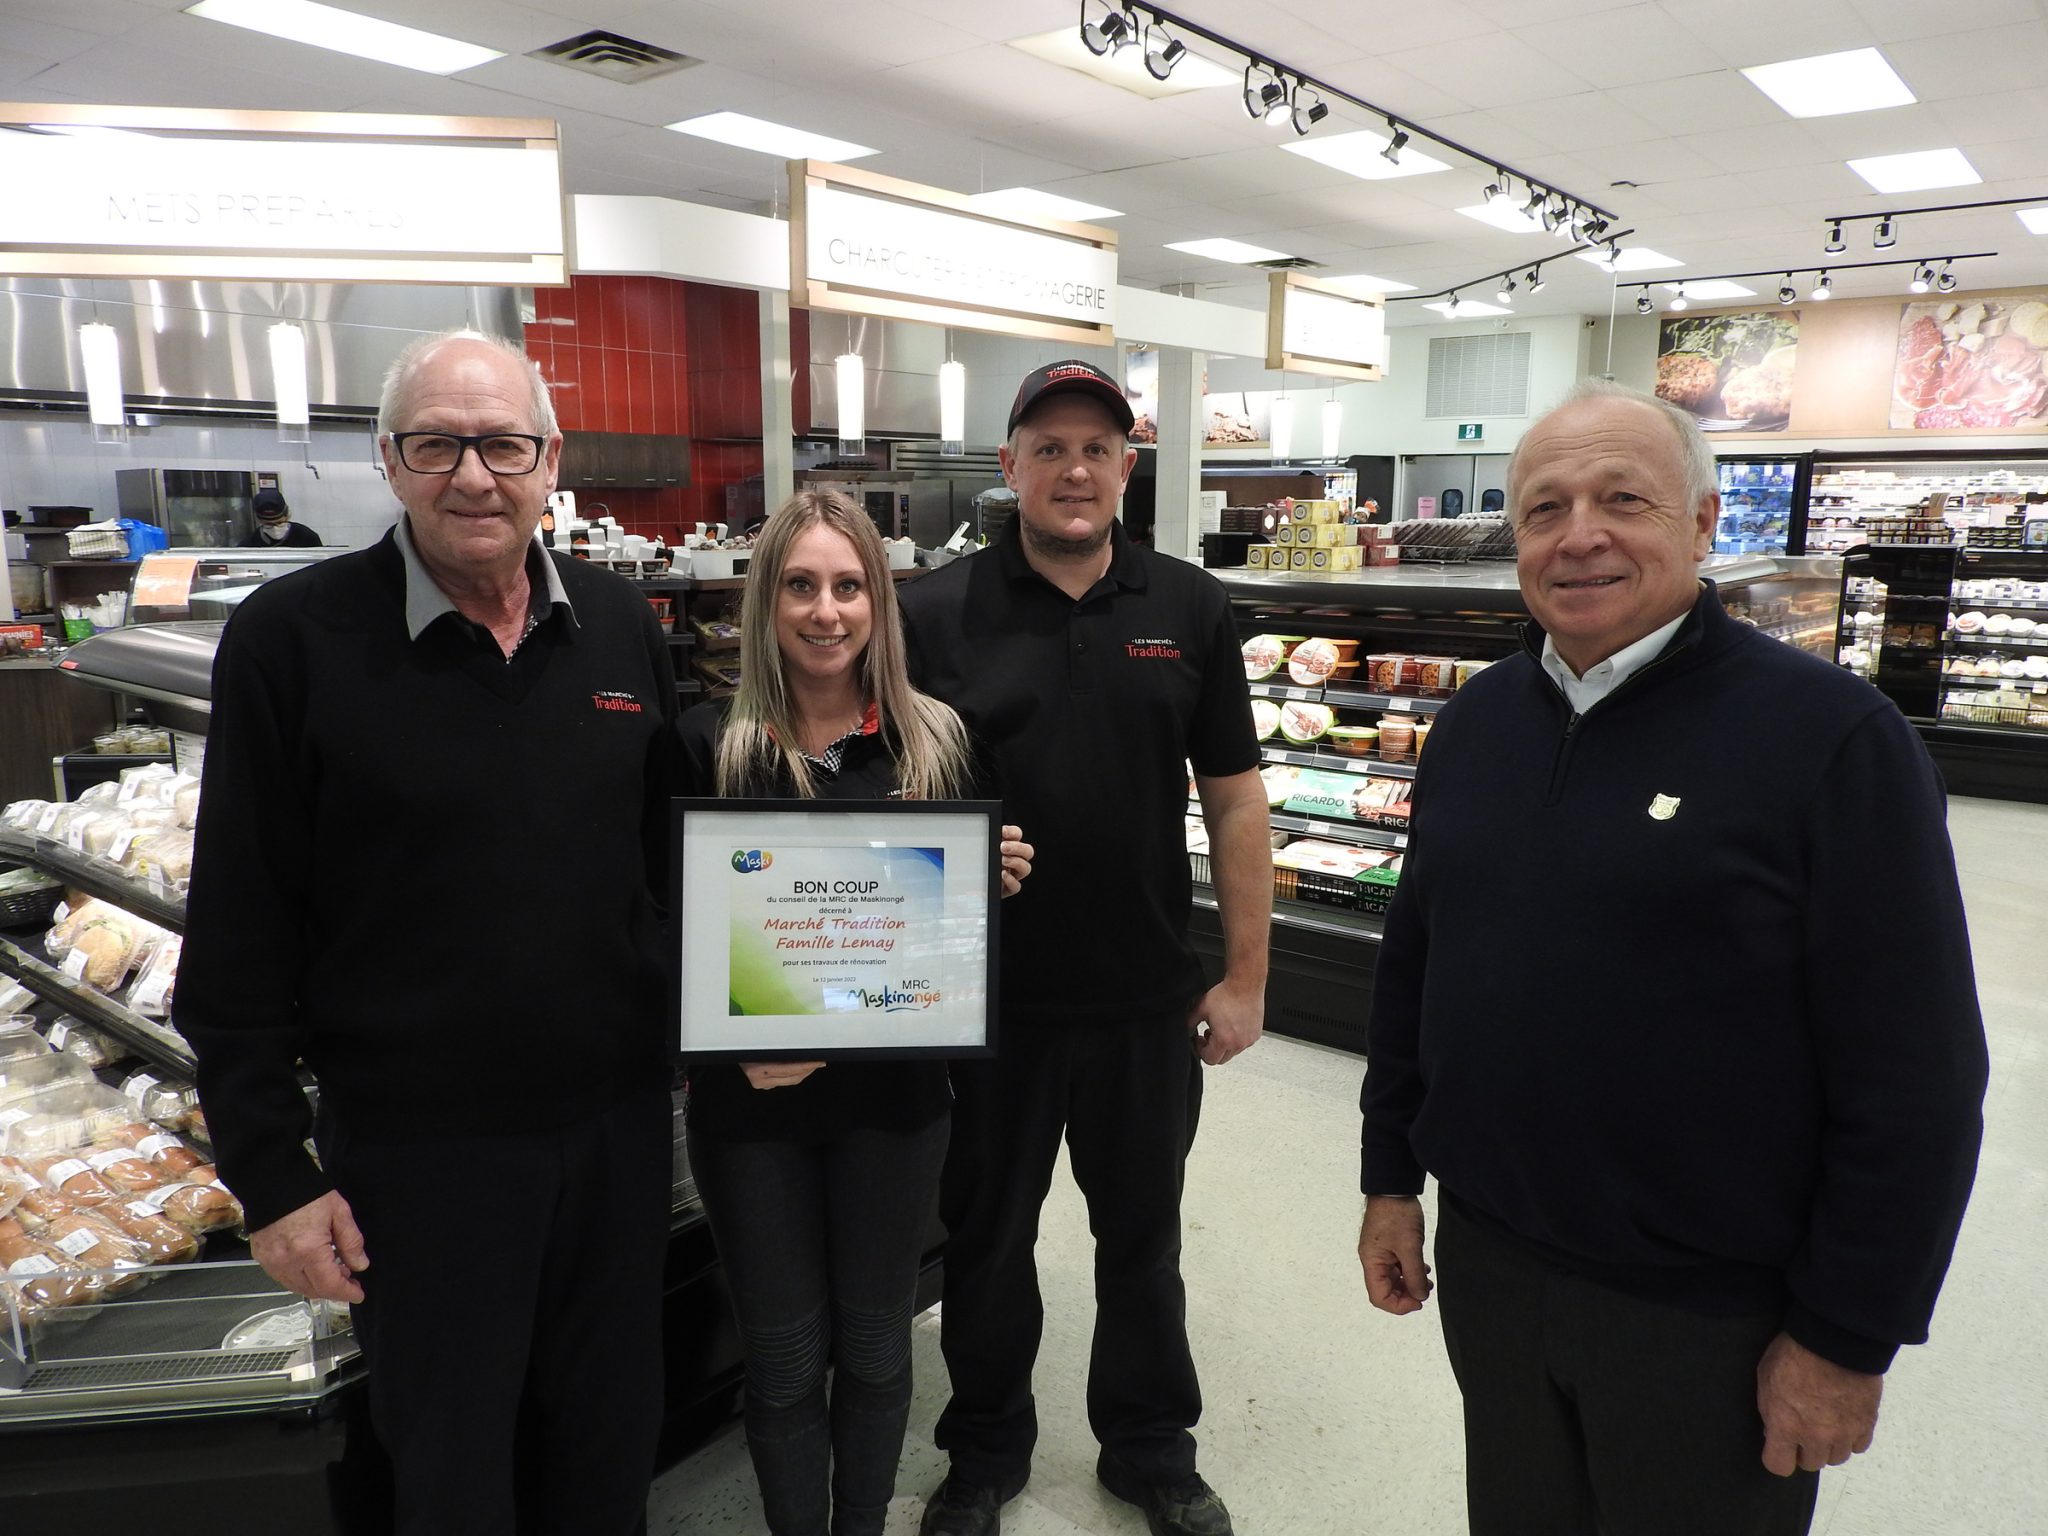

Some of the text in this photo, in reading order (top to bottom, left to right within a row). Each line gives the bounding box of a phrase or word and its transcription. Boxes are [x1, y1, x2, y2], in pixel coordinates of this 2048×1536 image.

[107, 191, 201, 224] METS
[1046, 367, 1097, 379] Traditio
[1124, 645, 1181, 659] Tradition
[592, 695, 642, 712] Tradition
[1292, 793, 1345, 807] RICARDO
[735, 850, 770, 869] Maski
[794, 881, 879, 894] BON COUP
[779, 895, 806, 903] conseil
[808, 895, 818, 903] de
[819, 895, 826, 903] la
[829, 895, 847, 903] MRC
[848, 895, 858, 903] de
[860, 895, 904, 904] Maskinongé
[764, 916, 907, 930] Marché Tradition
[776, 936, 895, 952] Famille Lemay
[782, 959, 799, 967] pour
[813, 958, 838, 966] travaux
[840, 958, 849, 966] de
[850, 957, 887, 966] rénovation
[902, 980, 931, 990] MRC
[848, 985, 941, 1008] Maskinongé
